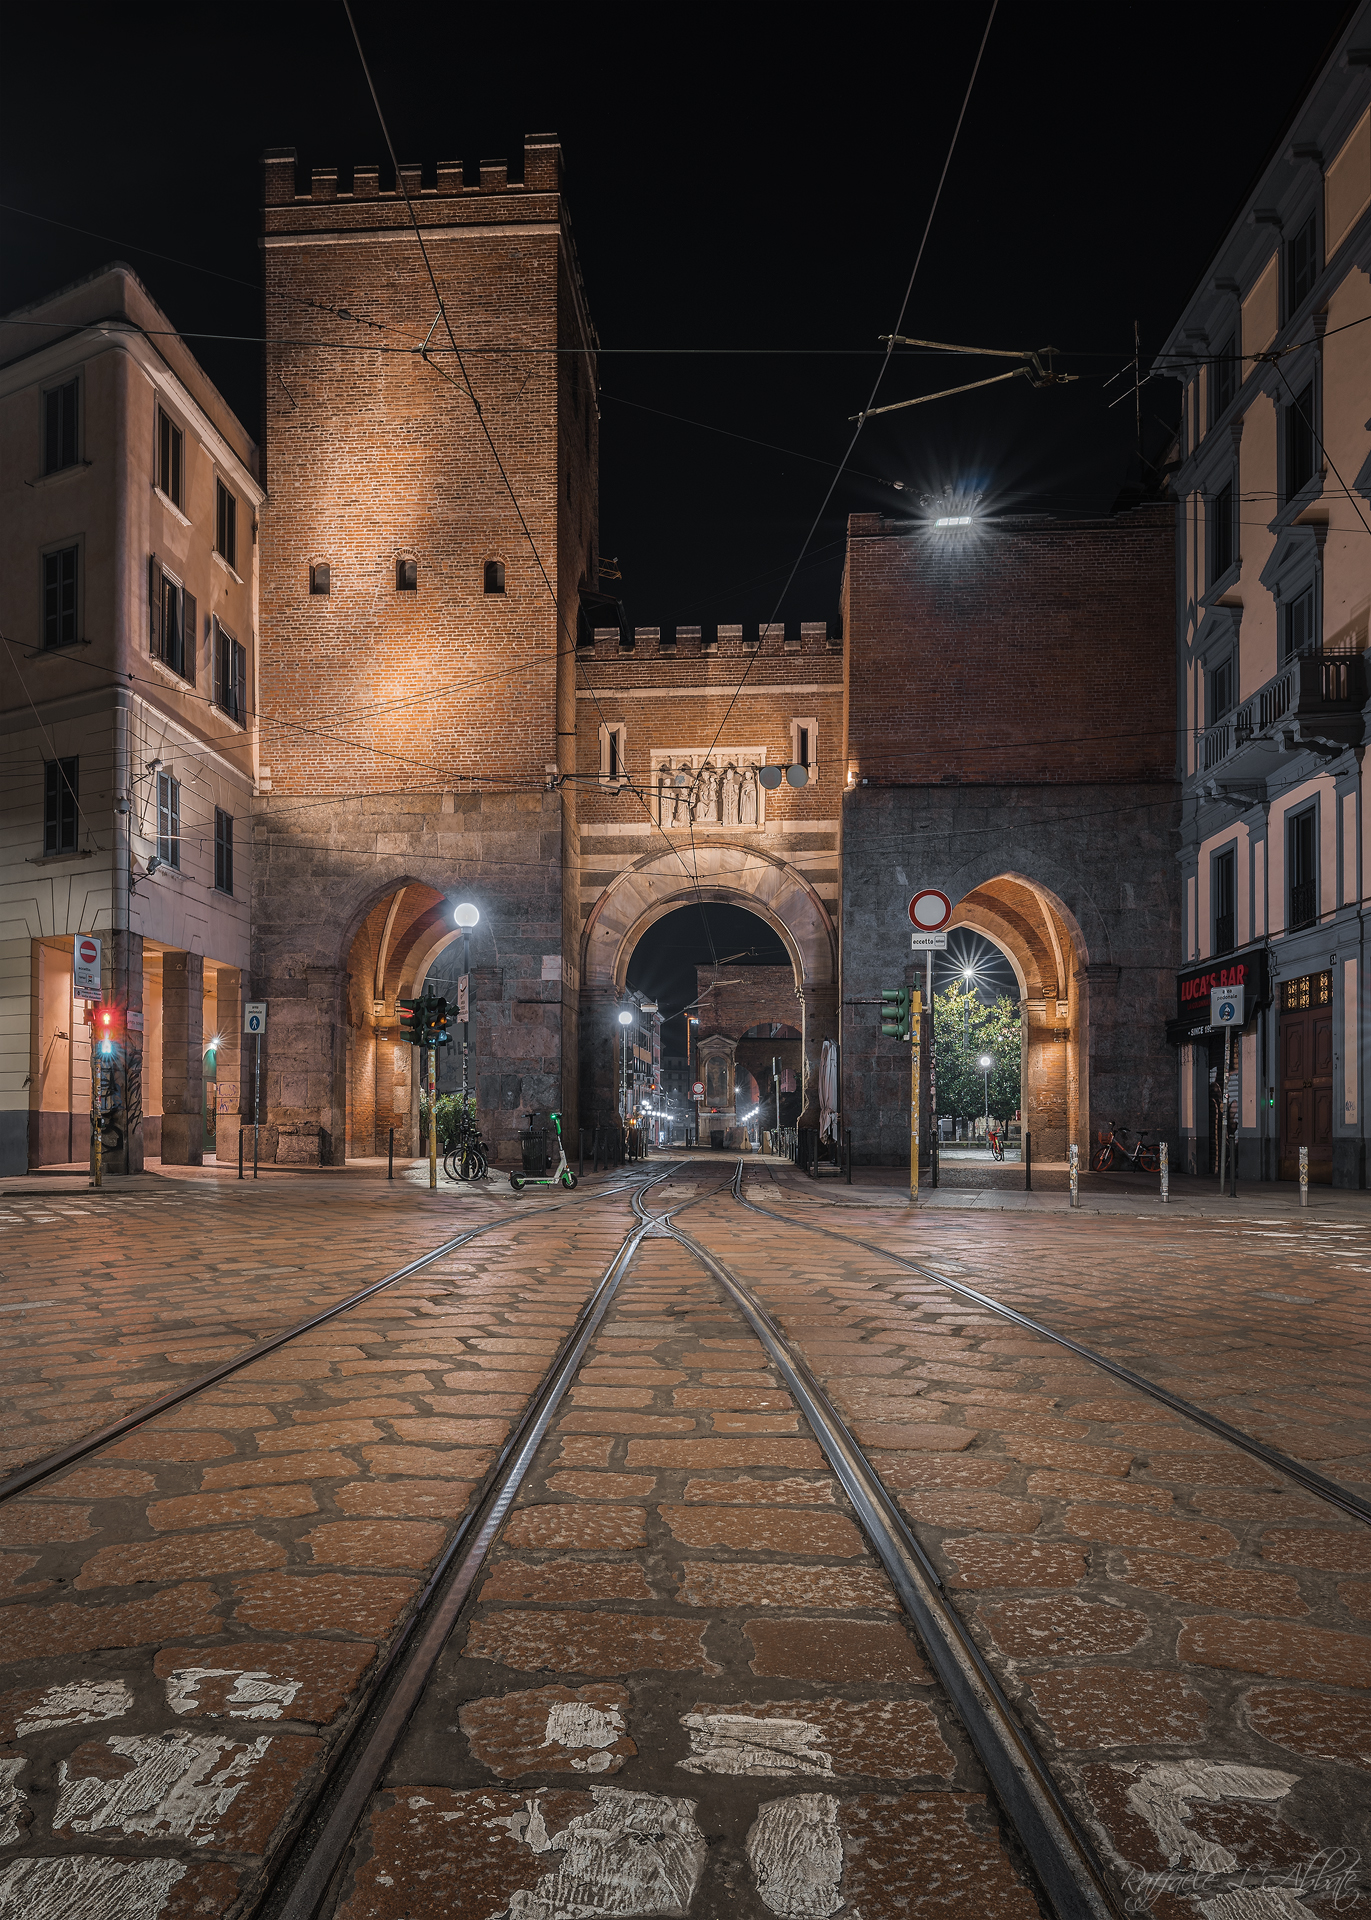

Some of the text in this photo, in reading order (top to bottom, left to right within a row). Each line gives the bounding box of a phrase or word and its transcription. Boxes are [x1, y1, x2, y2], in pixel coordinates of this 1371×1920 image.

[1181, 964, 1246, 1001] LUCA'S BAR
[1191, 1026, 1204, 1036] SINCE
